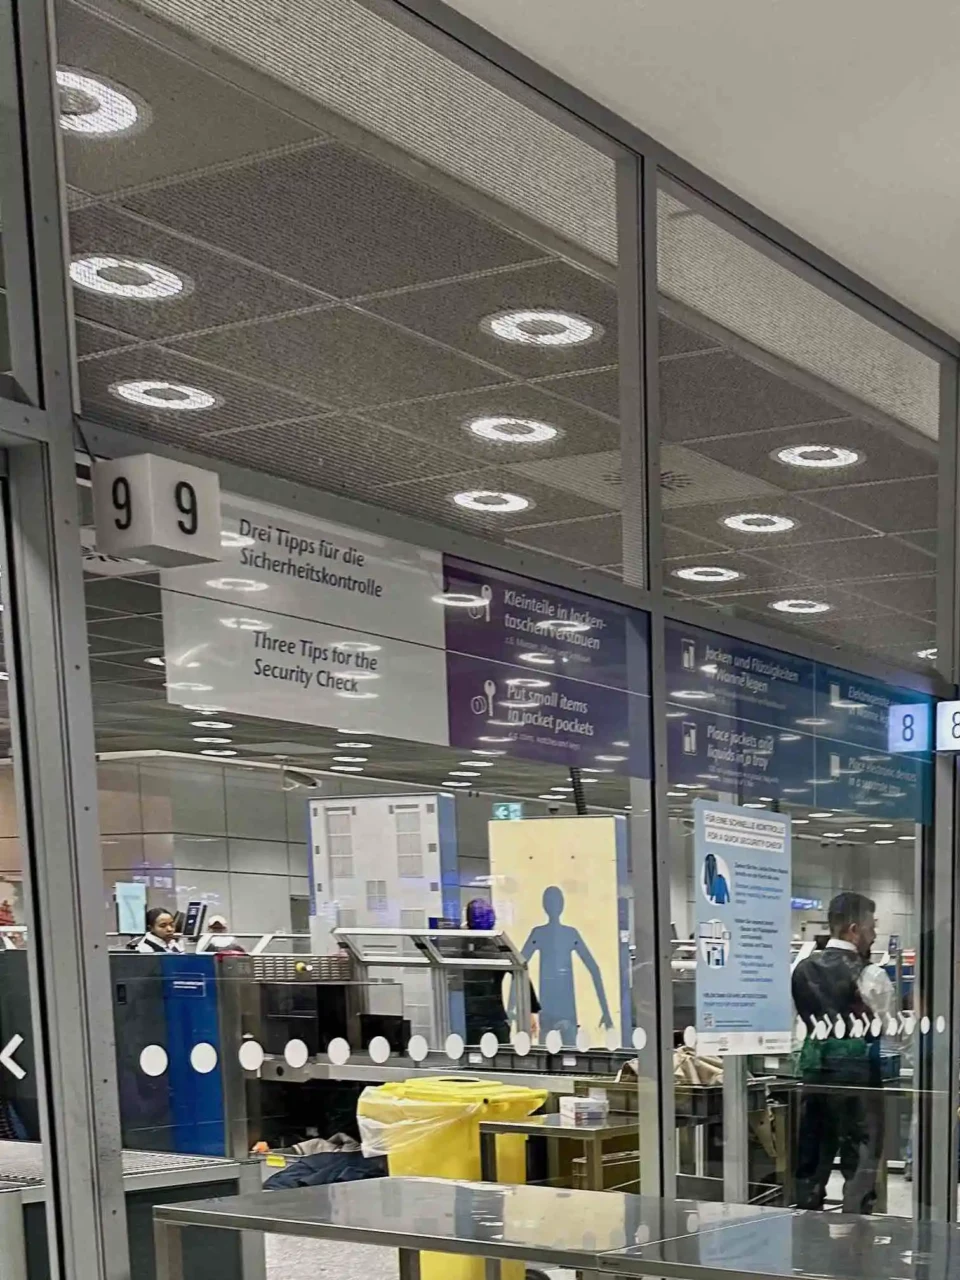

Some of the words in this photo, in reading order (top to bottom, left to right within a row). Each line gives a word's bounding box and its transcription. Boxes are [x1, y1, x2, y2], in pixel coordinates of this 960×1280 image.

[112, 476, 132, 530] 9
[174, 480, 198, 535] 9
[239, 518, 271, 543] Drei
[276, 528, 315, 556] Tipps
[317, 539, 339, 560] für
[342, 546, 365, 567] die
[239, 547, 383, 598] Sicherheitskontrolle
[504, 589, 555, 617] Kleinteile
[557, 604, 568, 620] in
[504, 614, 548, 637] taschen
[550, 627, 600, 650] verstauen
[252, 630, 296, 655] Three
[299, 639, 328, 663] Tips
[330, 646, 351, 665] for
[352, 650, 378, 671] the
[734, 656, 751, 669] und
[253, 658, 313, 688] Security
[316, 670, 359, 693] Check
[507, 684, 526, 699] Put
[529, 690, 558, 708] small
[559, 693, 588, 714] items
[507, 705, 518, 722] in
[522, 709, 554, 729] jacket
[554, 718, 594, 737] pockets
[707, 725, 729, 742] Place
[902, 713, 914, 742] 8
